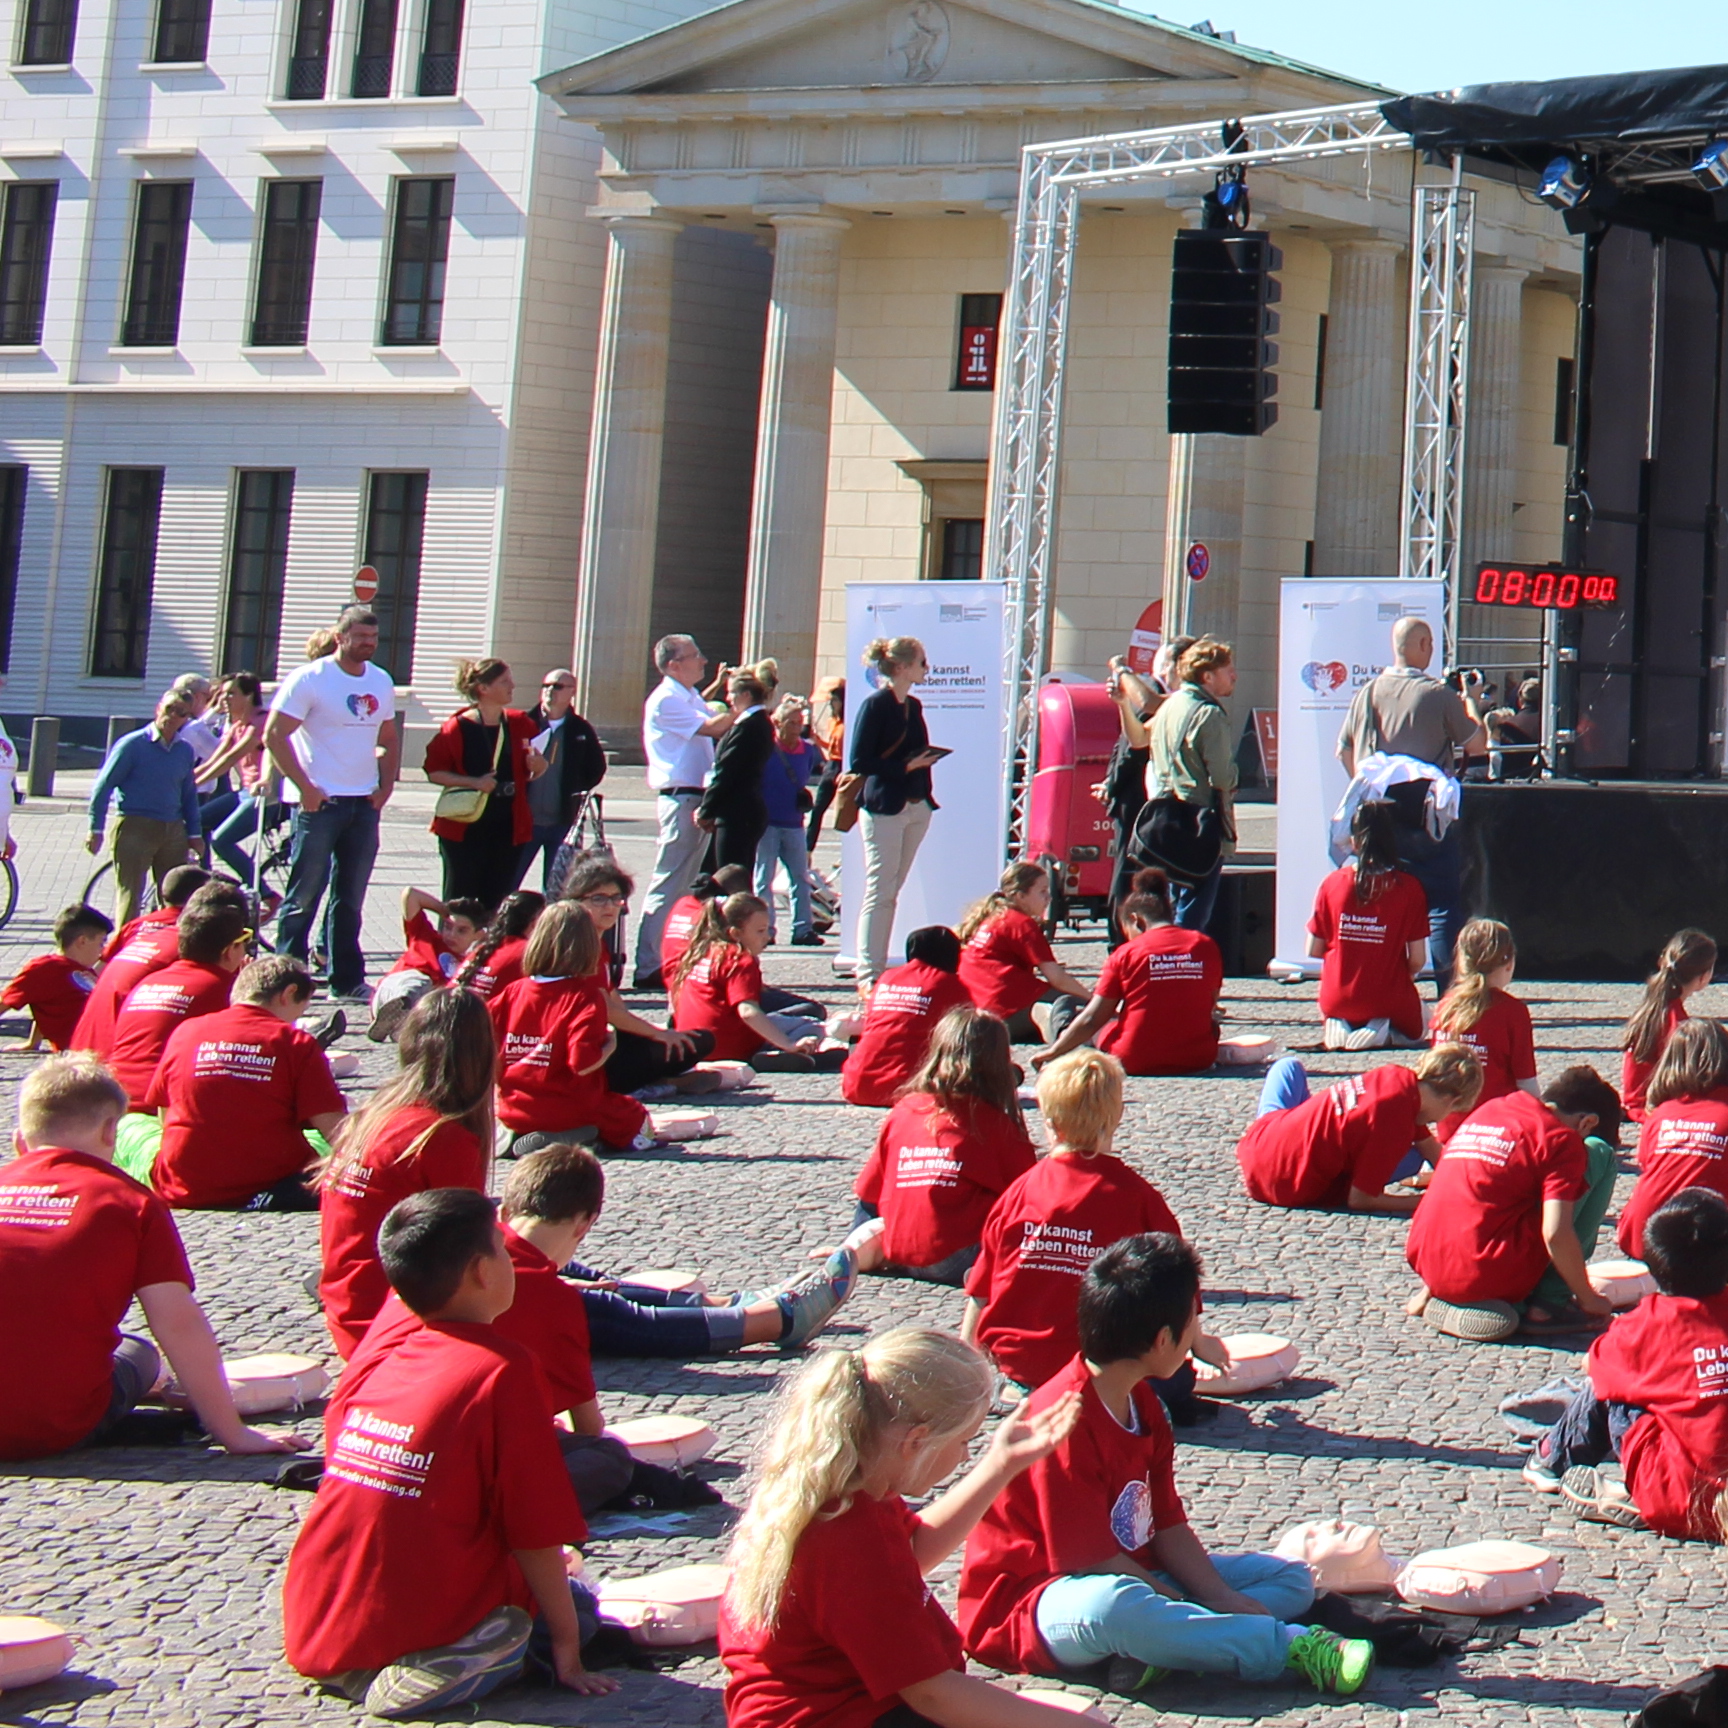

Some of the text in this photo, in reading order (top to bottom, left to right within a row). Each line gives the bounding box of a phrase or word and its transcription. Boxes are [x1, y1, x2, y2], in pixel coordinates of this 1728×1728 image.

[1475, 569, 1581, 608] 08:00
[933, 665, 970, 675] kannst
[1352, 665, 1368, 675] Du
[949, 675, 986, 686] retten!
[1340, 912, 1378, 924] Du kannst
[1150, 953, 1192, 962] Du kannst
[1150, 961, 1203, 971] Leben retten!
[878, 984, 922, 994] Du kannst
[159, 993, 195, 1005] retten!
[876, 991, 932, 1005] Leben retten!
[507, 1032, 520, 1044] Du
[199, 1041, 262, 1054] Du kannst
[197, 1051, 277, 1067] Leben retten!
[1469, 1123, 1505, 1136] kannst
[1661, 1118, 1717, 1132] Du kannst
[1475, 1135, 1515, 1153] retten!
[1658, 1130, 1728, 1146] Leben retten!
[900, 1145, 950, 1159] Du kannst
[897, 1158, 963, 1172] Leben retten!
[14, 1195, 80, 1208] retten!
[1024, 1221, 1093, 1243] Du kannst
[1020, 1236, 1062, 1253] Leben
[1693, 1347, 1717, 1363] Du
[346, 1408, 415, 1443] Du kannst
[338, 1428, 435, 1470] Leben retten!
